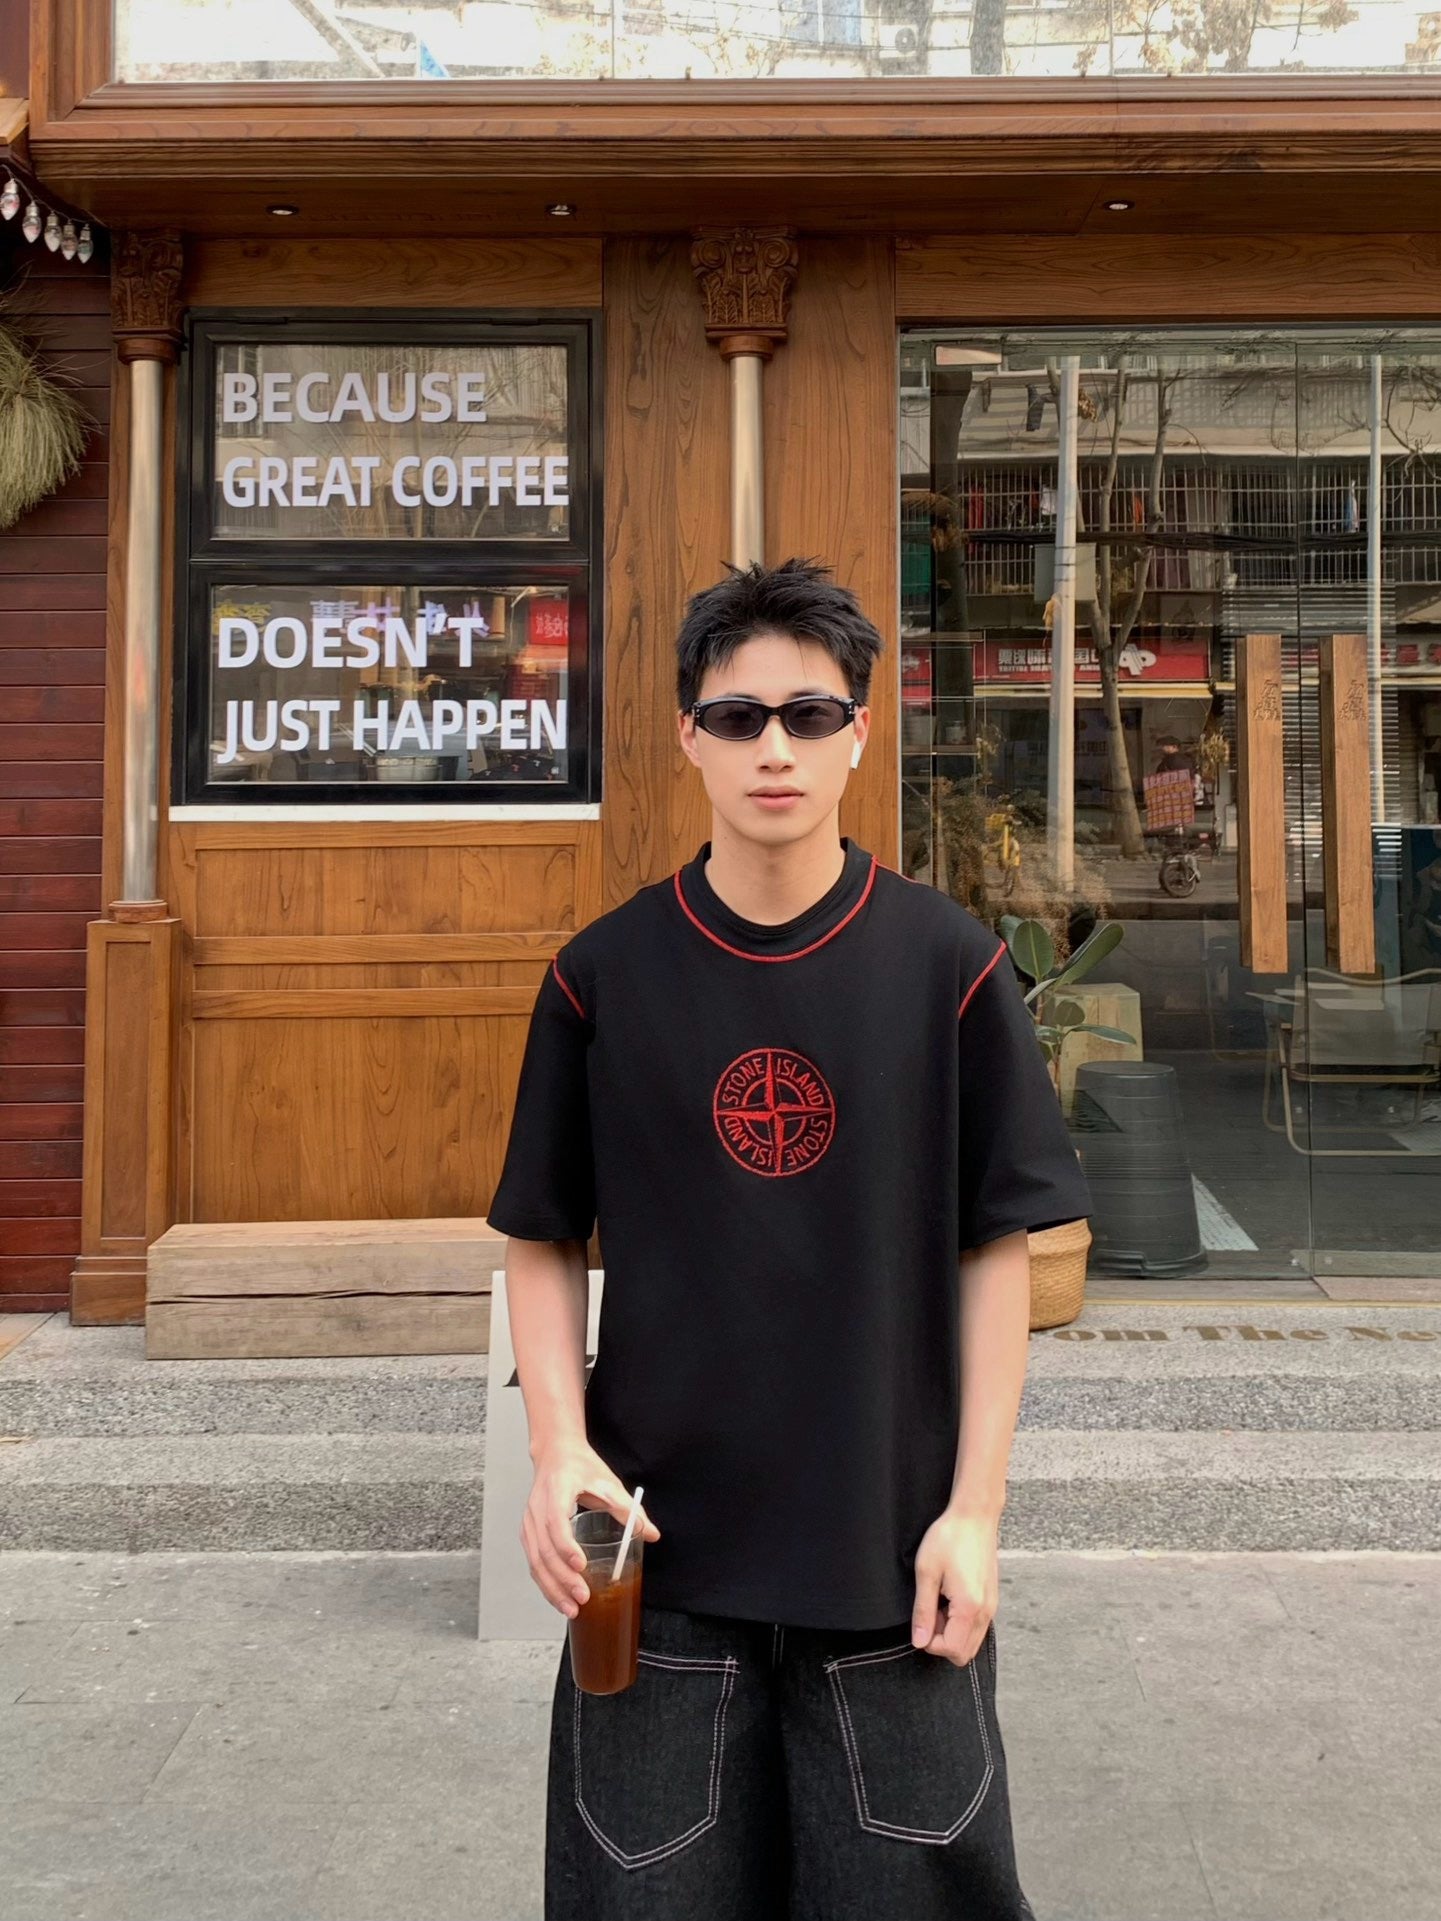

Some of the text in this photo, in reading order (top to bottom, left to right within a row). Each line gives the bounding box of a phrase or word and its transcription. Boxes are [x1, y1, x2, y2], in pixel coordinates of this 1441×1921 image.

[223, 372, 487, 424] BECAUSE
[222, 456, 570, 508] GREAT COFFEE
[217, 616, 484, 668] DOESN'T
[217, 699, 567, 764] JUST HAPPEN
[722, 1057, 824, 1106] STONE ISLAND
[724, 1116, 828, 1167] STONE ISLAND
[1051, 1324, 1441, 1343] om The Ne
